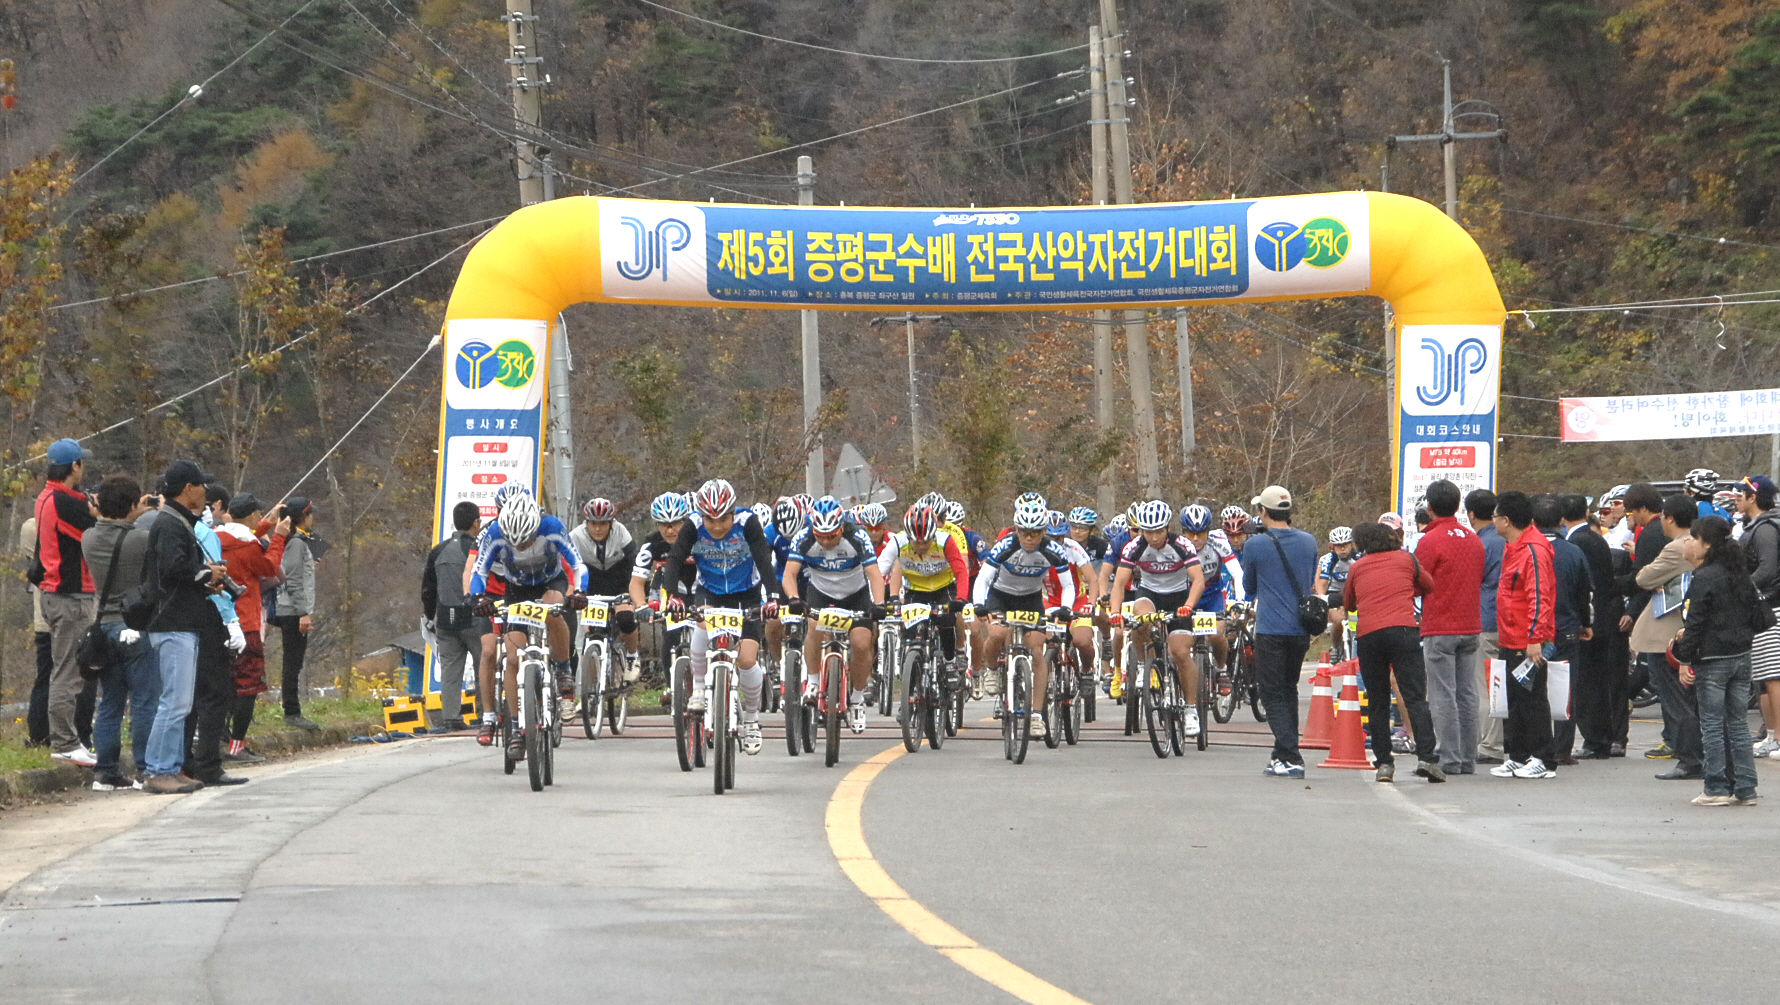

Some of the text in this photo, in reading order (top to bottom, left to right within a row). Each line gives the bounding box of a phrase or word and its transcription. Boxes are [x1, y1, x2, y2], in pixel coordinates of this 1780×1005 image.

[717, 224, 1237, 284] 제5회 증평군수배 전국산악자전거대회
[856, 291, 877, 300] 증평군
[1014, 565, 1042, 575] SMF
[1149, 562, 1175, 571] SMF
[514, 603, 544, 620] 132
[583, 607, 605, 620] 119
[904, 607, 927, 620] 117
[1011, 610, 1035, 622] 128
[708, 614, 739, 629] 118
[822, 613, 849, 628] 127
